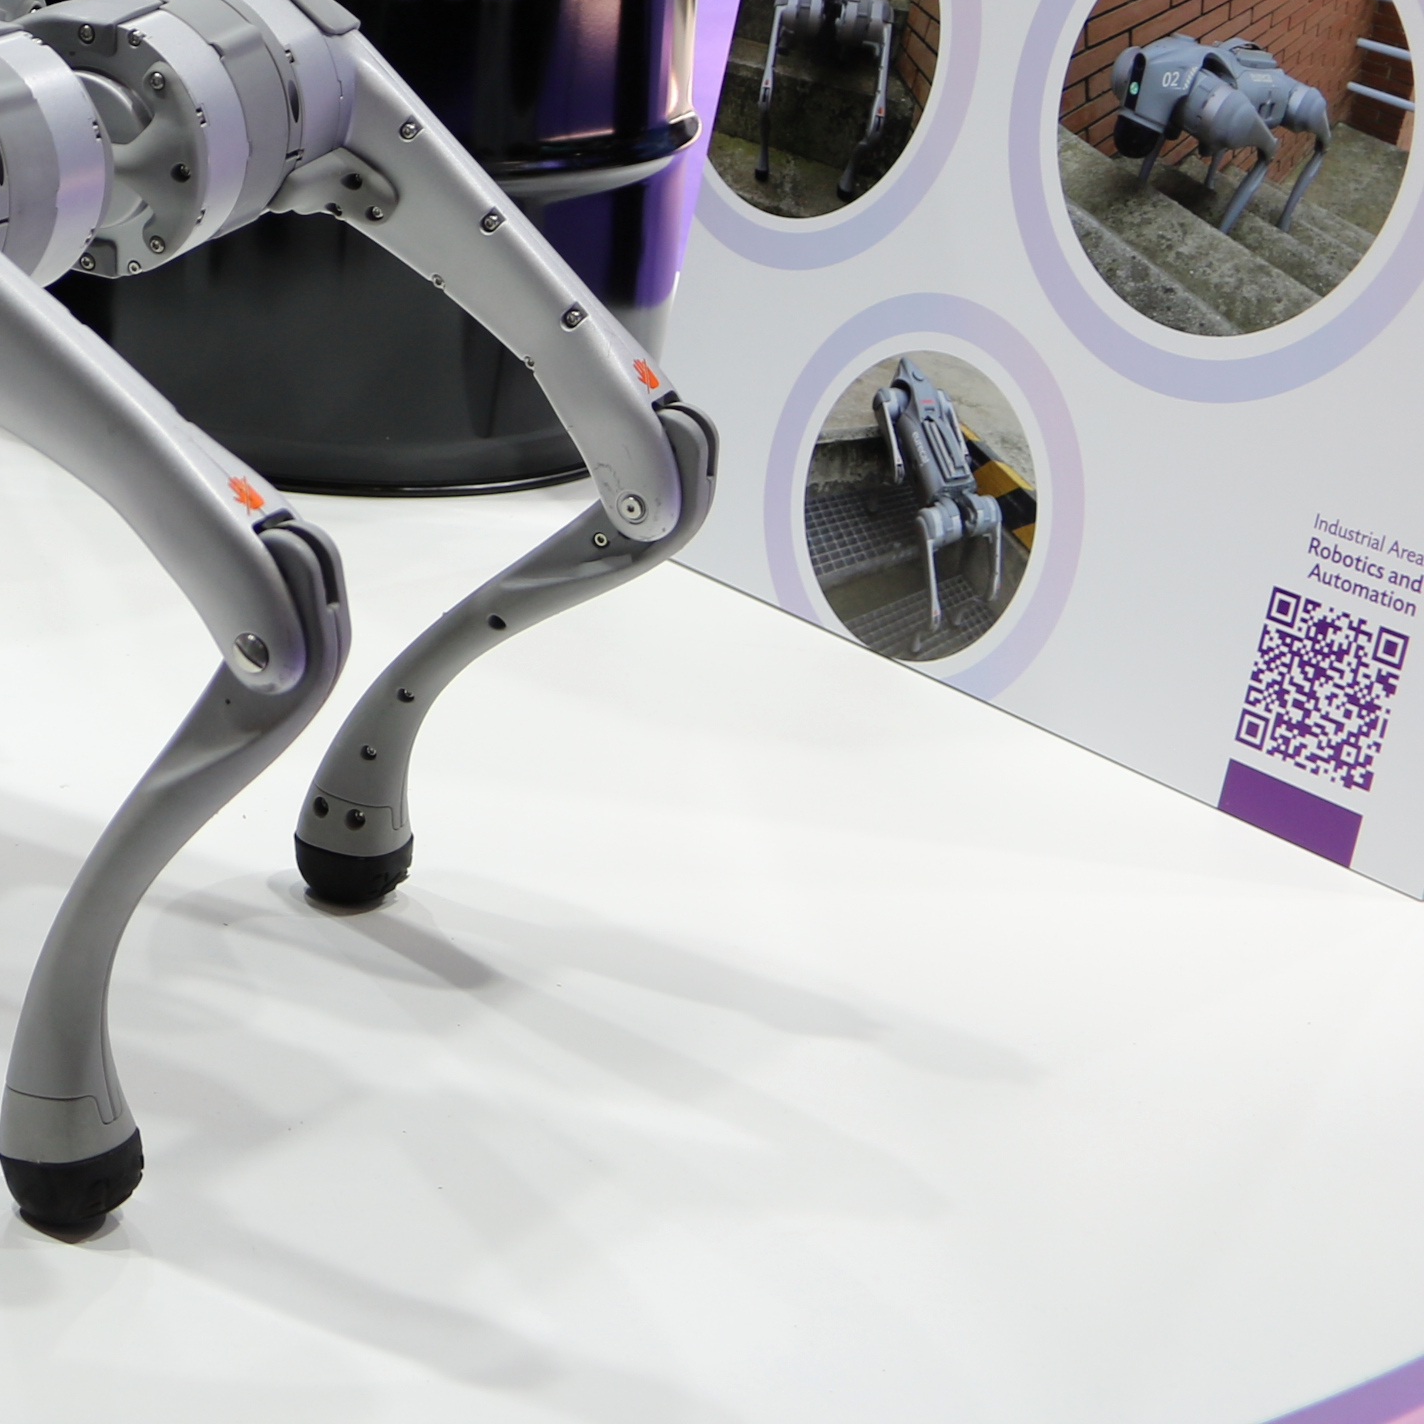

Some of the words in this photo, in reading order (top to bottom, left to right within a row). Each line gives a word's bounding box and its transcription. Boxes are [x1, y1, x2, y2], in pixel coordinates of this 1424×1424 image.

[1314, 513, 1386, 552] Industrial
[1307, 563, 1417, 617] Automation
[1308, 536, 1385, 579] Robotics
[1388, 571, 1424, 594] and
